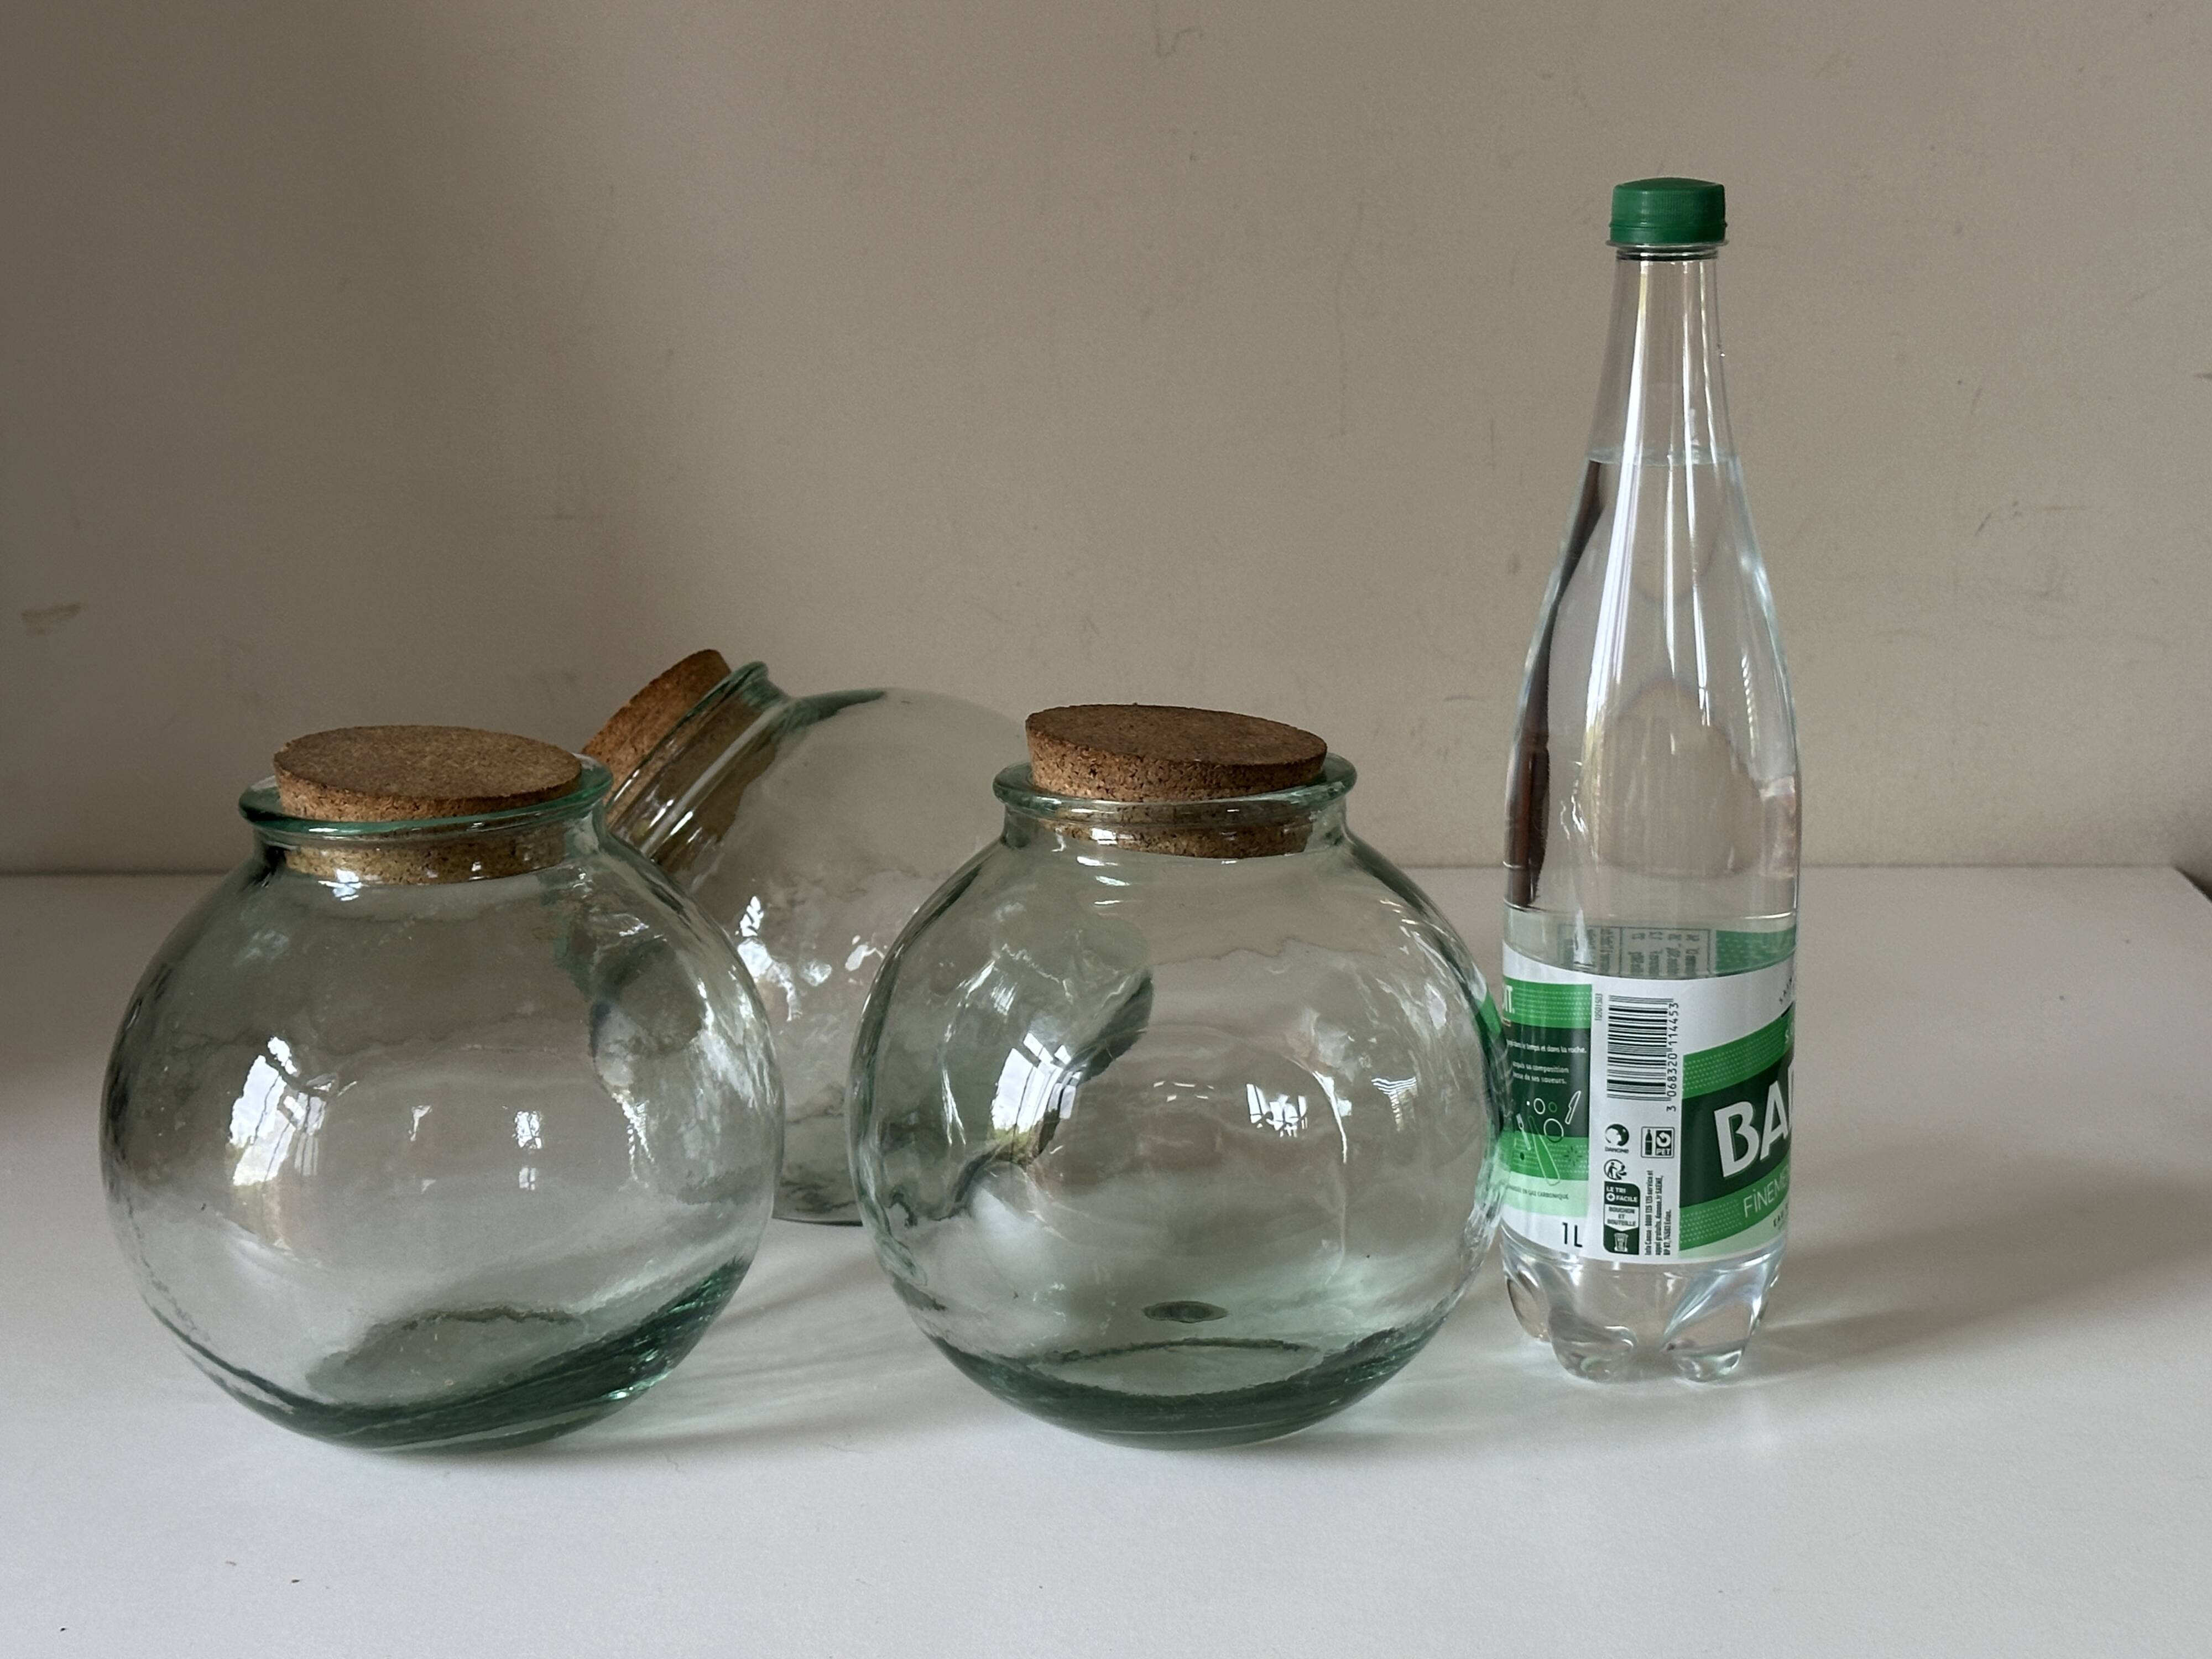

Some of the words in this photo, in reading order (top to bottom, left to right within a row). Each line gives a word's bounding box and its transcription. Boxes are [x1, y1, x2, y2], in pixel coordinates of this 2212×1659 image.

[1668, 1003, 1679, 1045] 114453
[1666, 1053, 1678, 1097] 068320
[1616, 1194, 1638, 1203] FACILE
[1608, 1206, 1635, 1214] BOUCHON
[1607, 1218, 1636, 1227] BOUTEILLE
